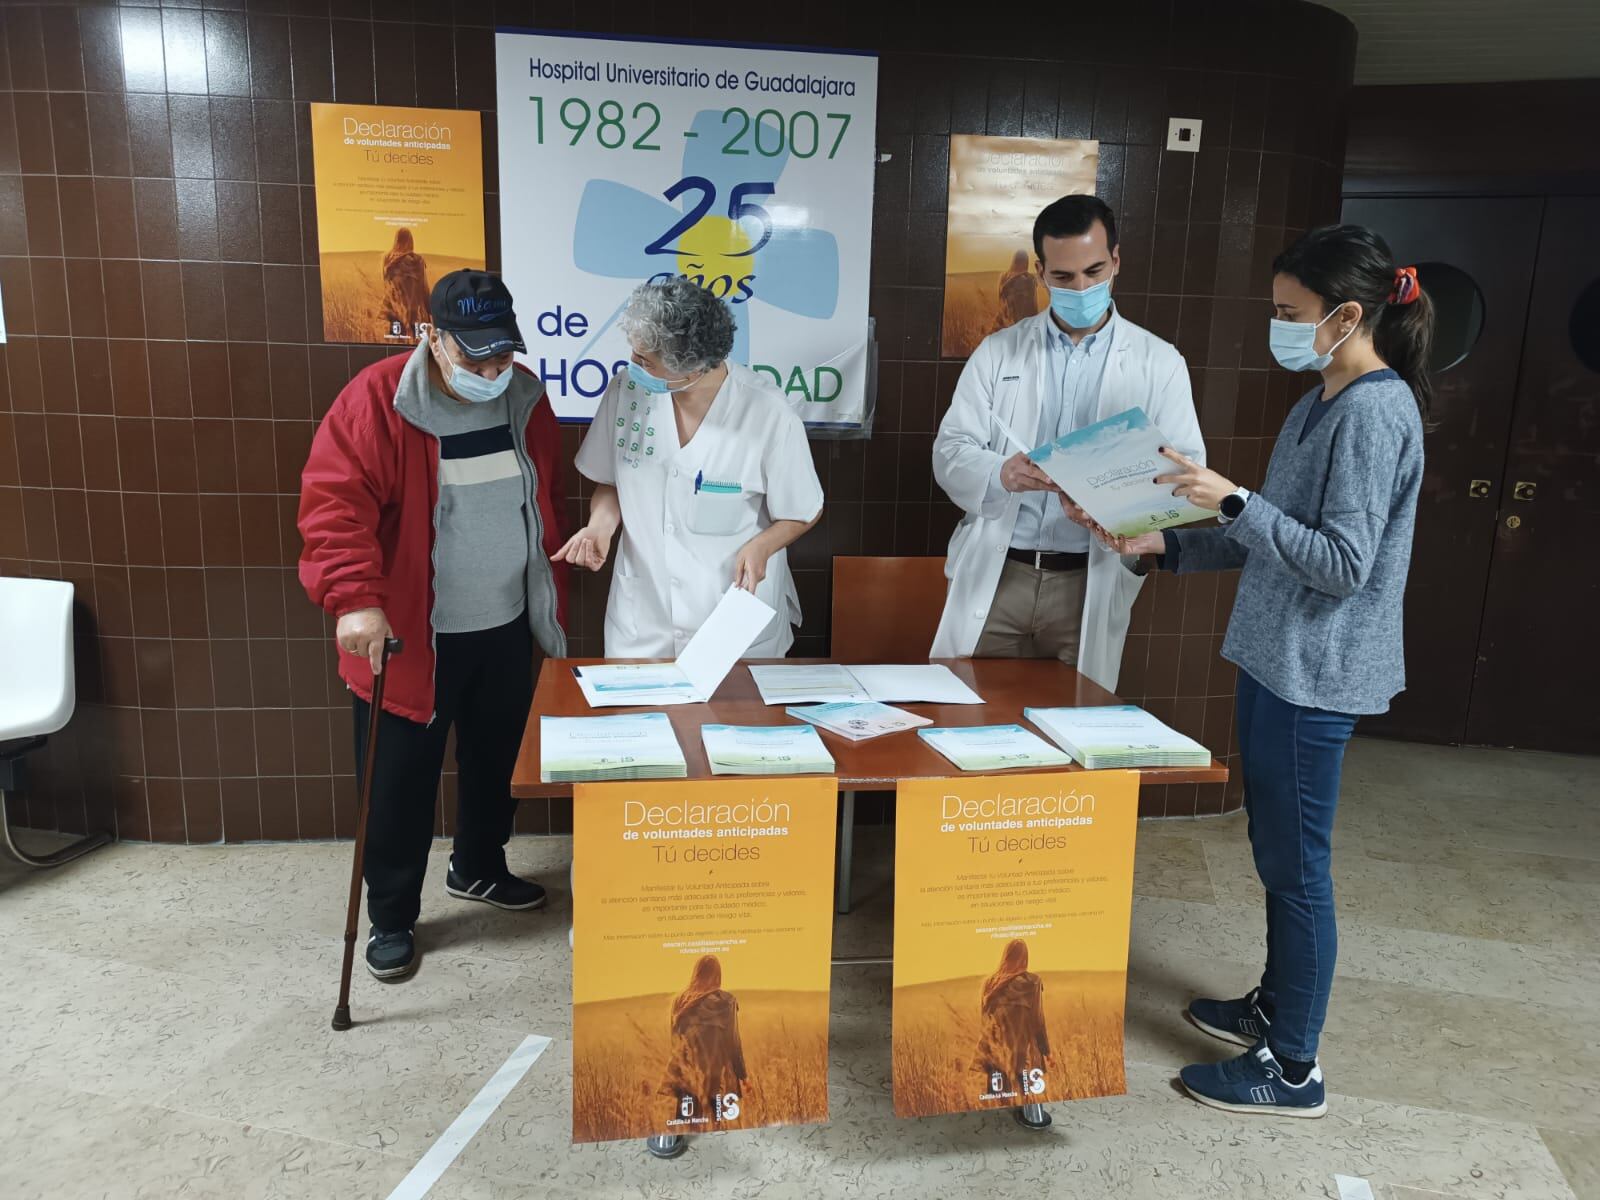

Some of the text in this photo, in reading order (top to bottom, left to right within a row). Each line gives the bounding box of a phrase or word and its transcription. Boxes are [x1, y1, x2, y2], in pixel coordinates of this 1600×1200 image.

[529, 57, 856, 99] Hospital Universitario de Guadalajara
[343, 117, 451, 140] Declaración
[529, 96, 661, 151] 1982
[721, 107, 852, 160] 2007
[344, 138, 451, 150] de voluntades anticipadas
[364, 149, 433, 166] Tú decides
[644, 176, 775, 256] 25
[537, 305, 588, 337] de
[624, 797, 791, 826] Declaración
[942, 789, 1095, 820] Declaración
[623, 826, 788, 840] de voluntades anticipadas
[941, 816, 1093, 833] de voluntades anticipadas
[652, 843, 760, 864] Tú decides
[968, 834, 1066, 854] Tú decides
